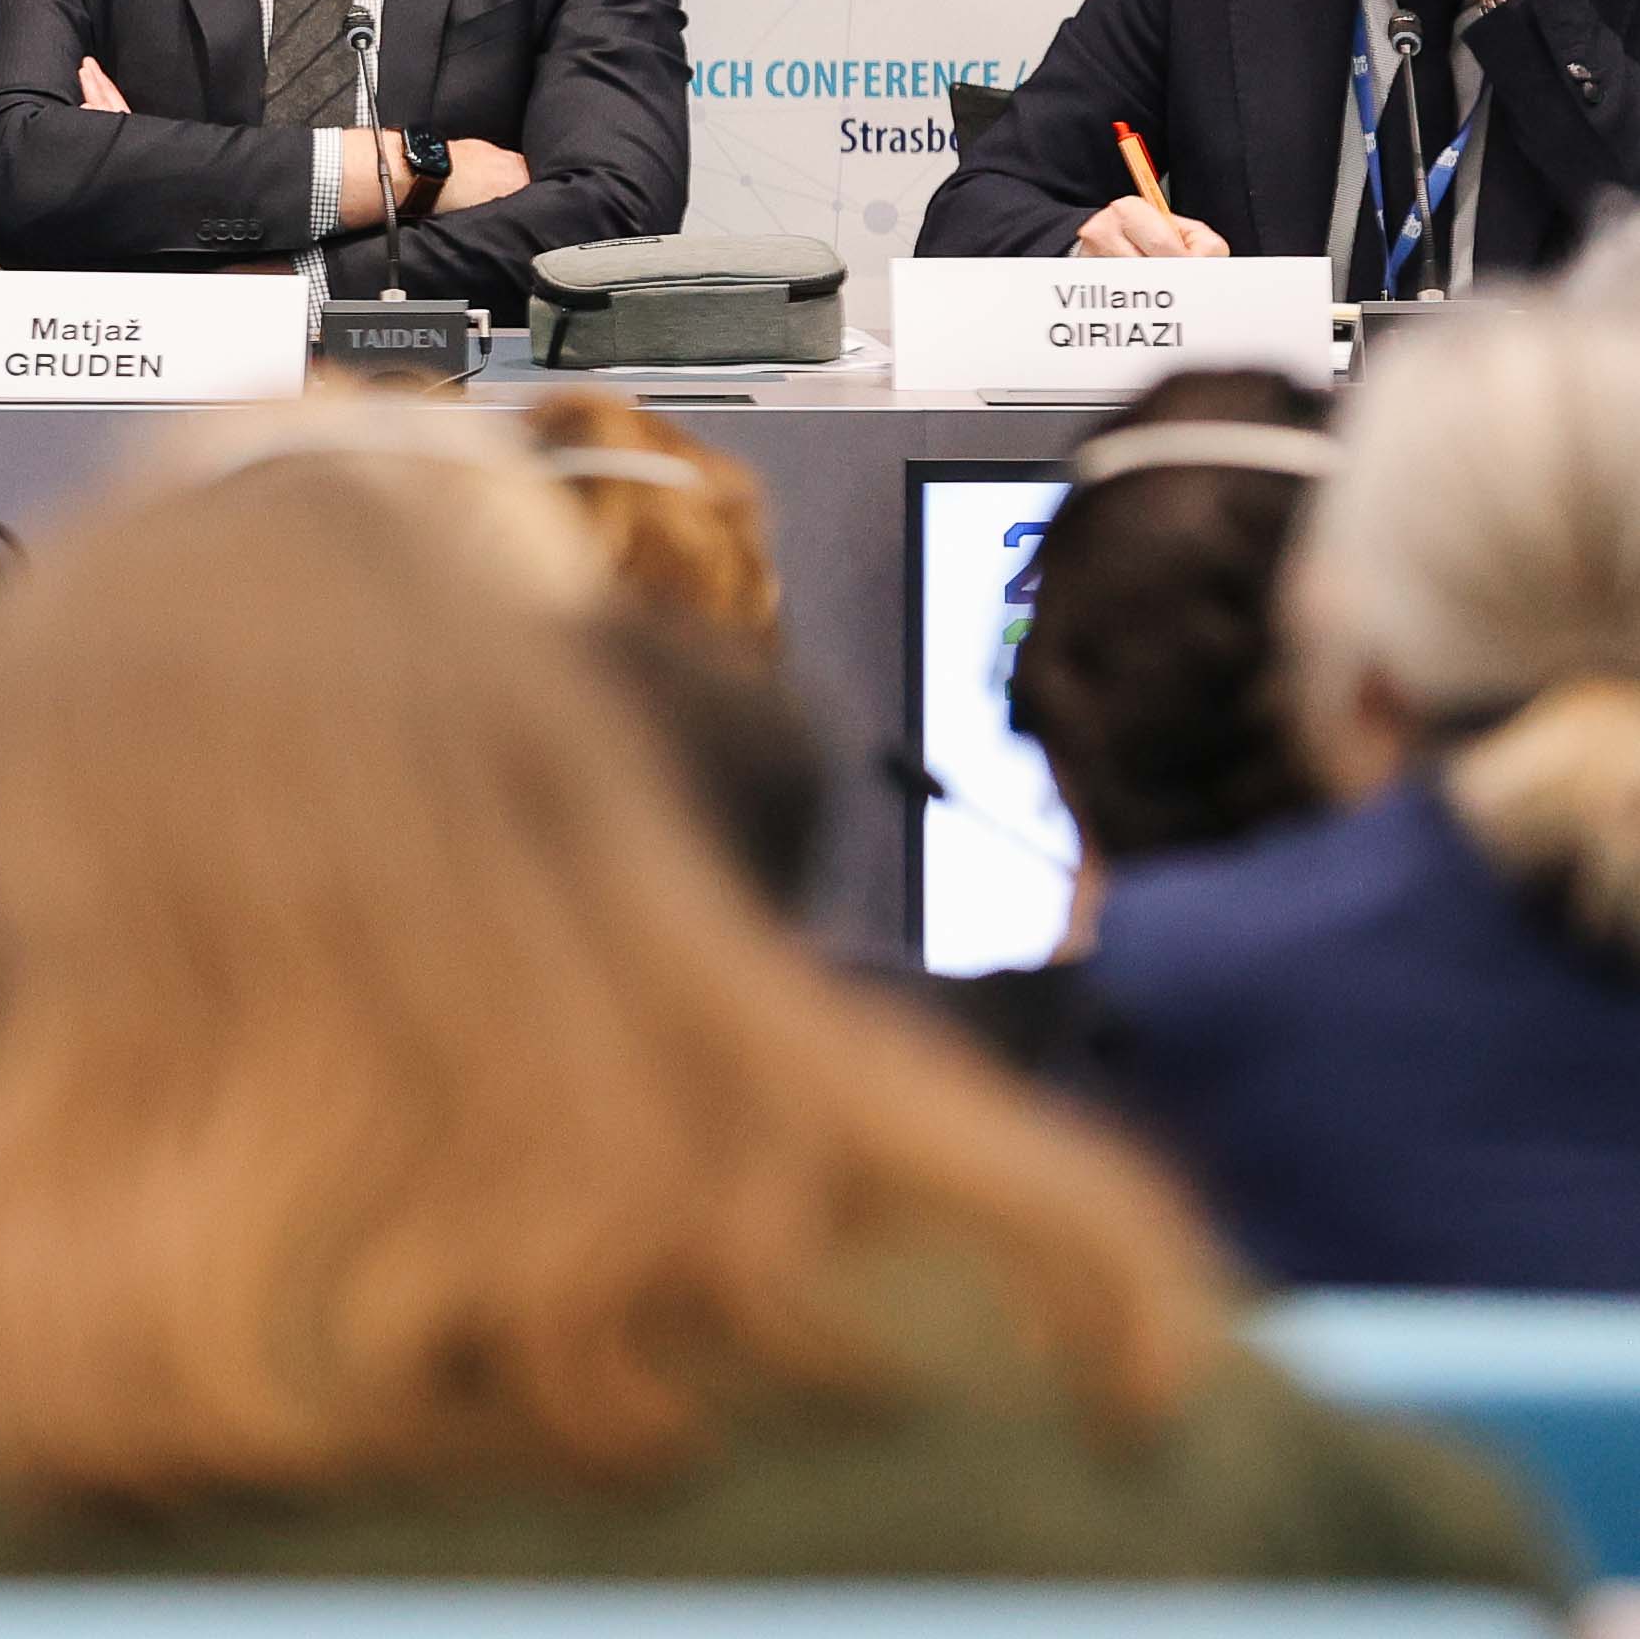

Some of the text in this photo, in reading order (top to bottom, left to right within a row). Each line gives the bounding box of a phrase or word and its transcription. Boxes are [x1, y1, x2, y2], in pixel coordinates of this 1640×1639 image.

[688, 59, 753, 98] NCH
[765, 59, 1001, 98] CONFERENCE
[840, 117, 961, 153] Strasb
[1055, 285, 1173, 309] Villano
[31, 317, 141, 347] Matjaž
[346, 328, 447, 349] TAIDEN
[1049, 322, 1181, 348] QIRIAZI
[5, 352, 161, 378] GRUDEN
